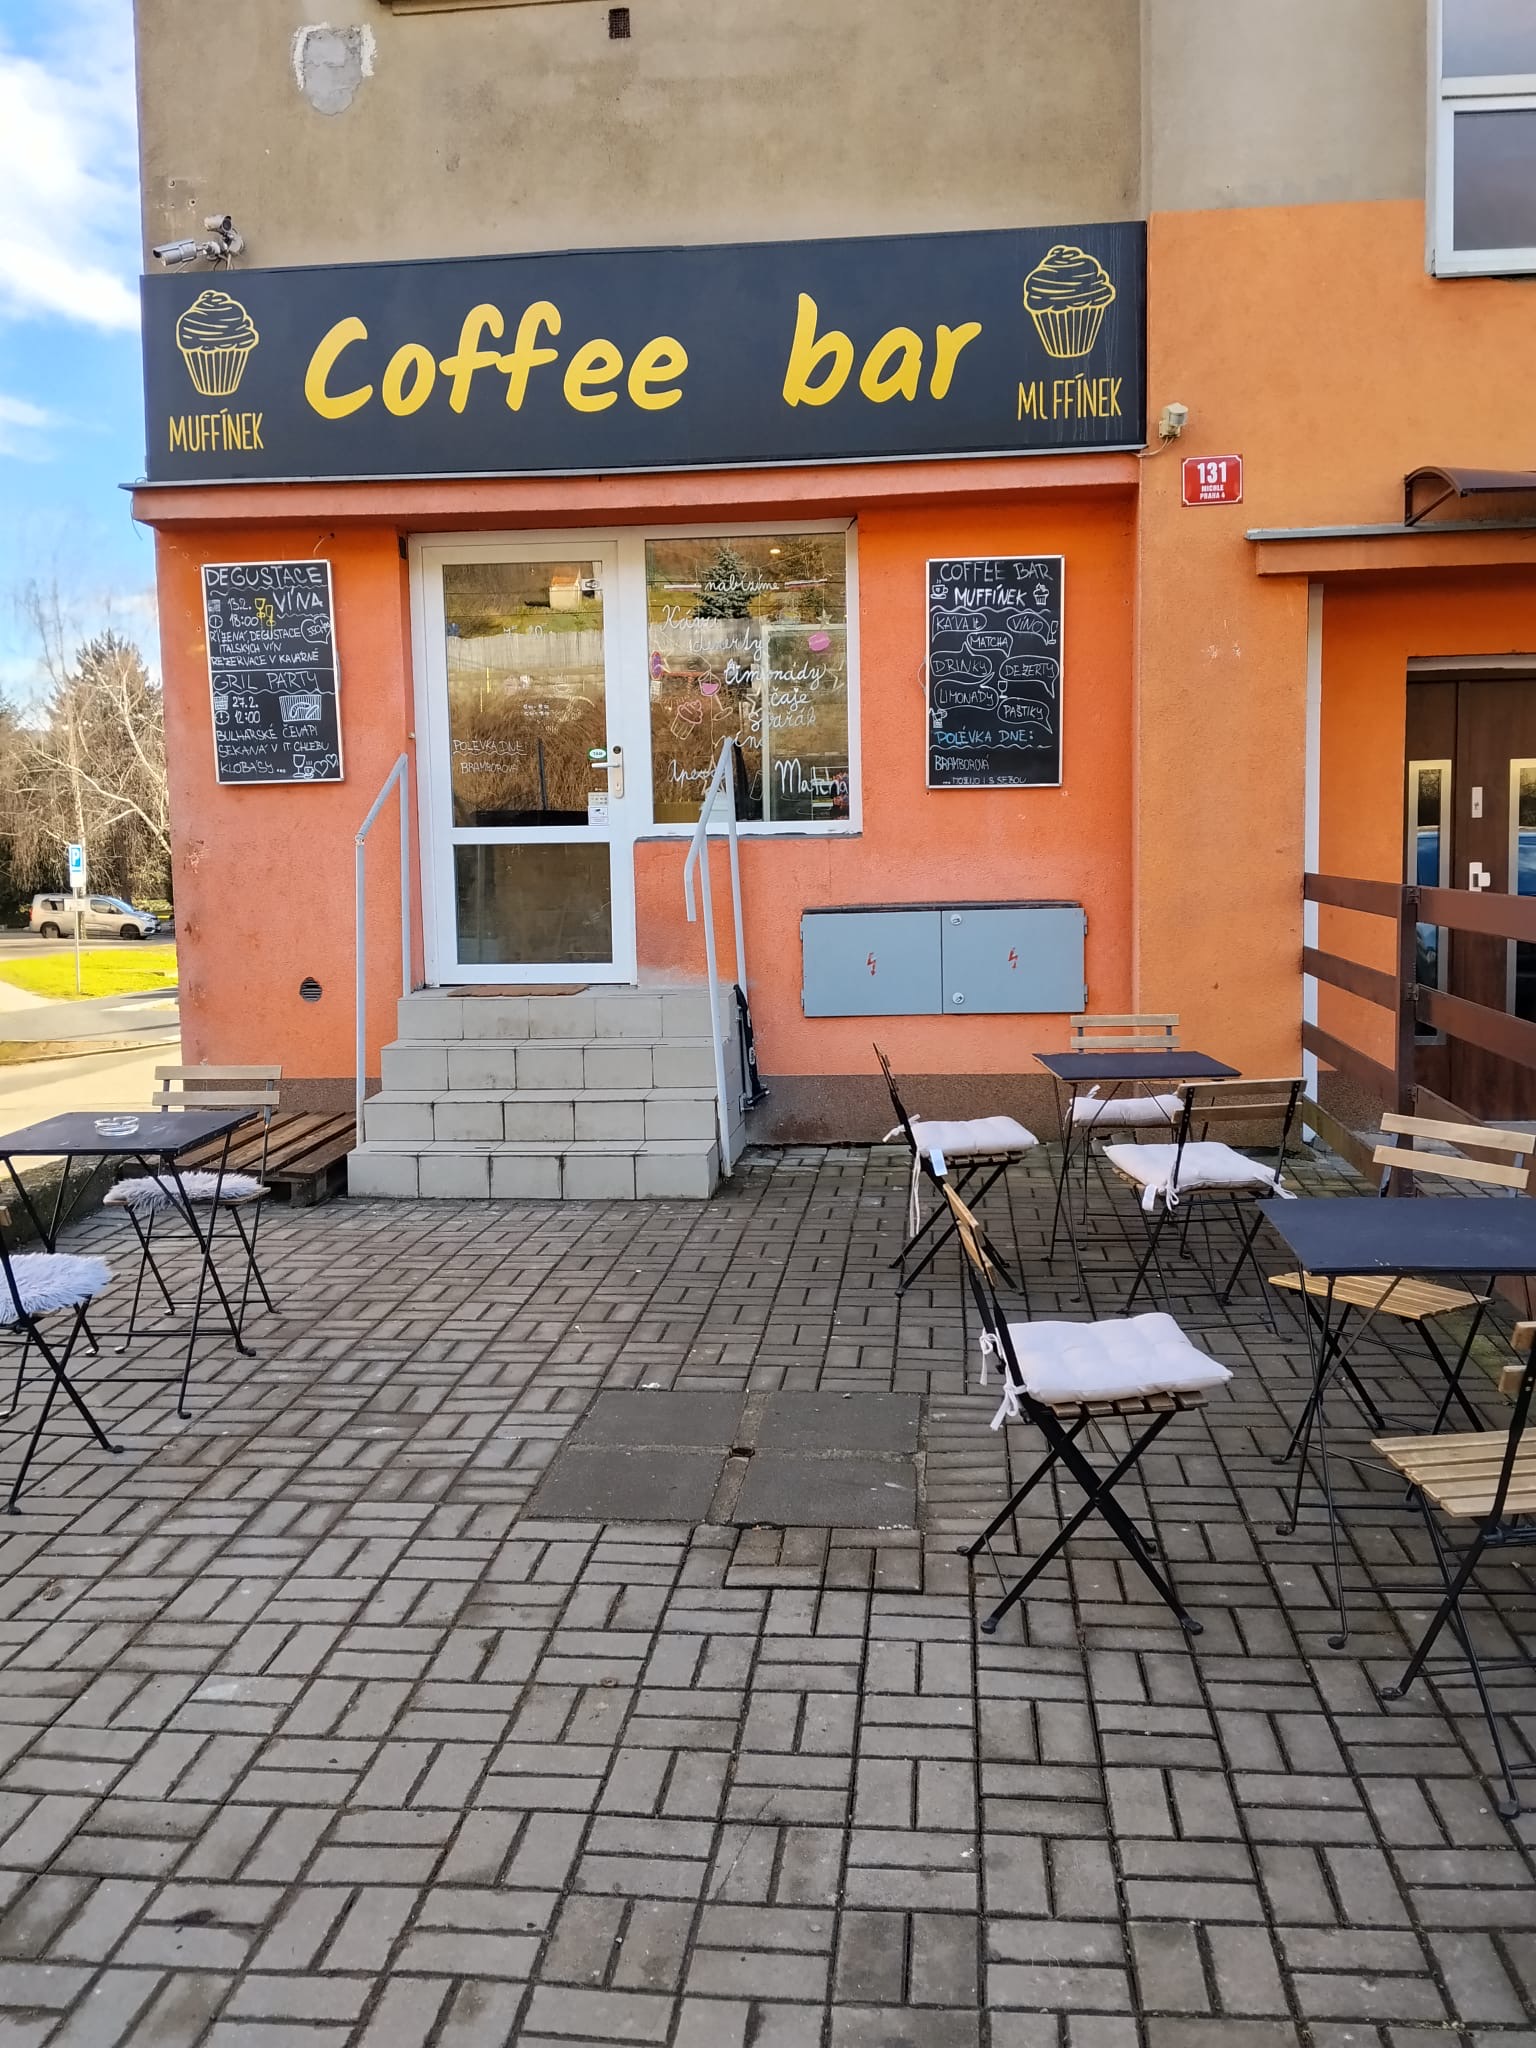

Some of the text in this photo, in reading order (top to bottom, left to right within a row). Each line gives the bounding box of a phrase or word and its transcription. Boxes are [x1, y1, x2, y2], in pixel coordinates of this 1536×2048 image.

[304, 293, 983, 420] Coffee bar
[169, 408, 264, 452] MUFFÍNEK
[1197, 461, 1227, 484] 131
[1199, 492, 1220, 500] PRAHA
[206, 566, 322, 589] DEGUSTACE
[940, 561, 1053, 582] COFFEE BAR
[272, 586, 323, 613] VÍNA
[954, 584, 1027, 607] MUFFÍNEK
[936, 616, 969, 631] KÁVA
[1012, 615, 1044, 633] VÍNO
[249, 628, 302, 641] DEGUSTACE
[969, 636, 1008, 648] MATCHA
[269, 655, 277, 663] V
[933, 659, 988, 675] DRINKY
[1005, 662, 1055, 678] DEZERTY
[213, 674, 258, 691] GRIL
[232, 696, 259, 708] 27.2.
[234, 711, 261, 724] 12:00
[1003, 704, 1043, 720] PAŠTIKY
[934, 725, 992, 745] POLÉVKA
[271, 743, 278, 753] V
[71, 849, 80, 867] P
